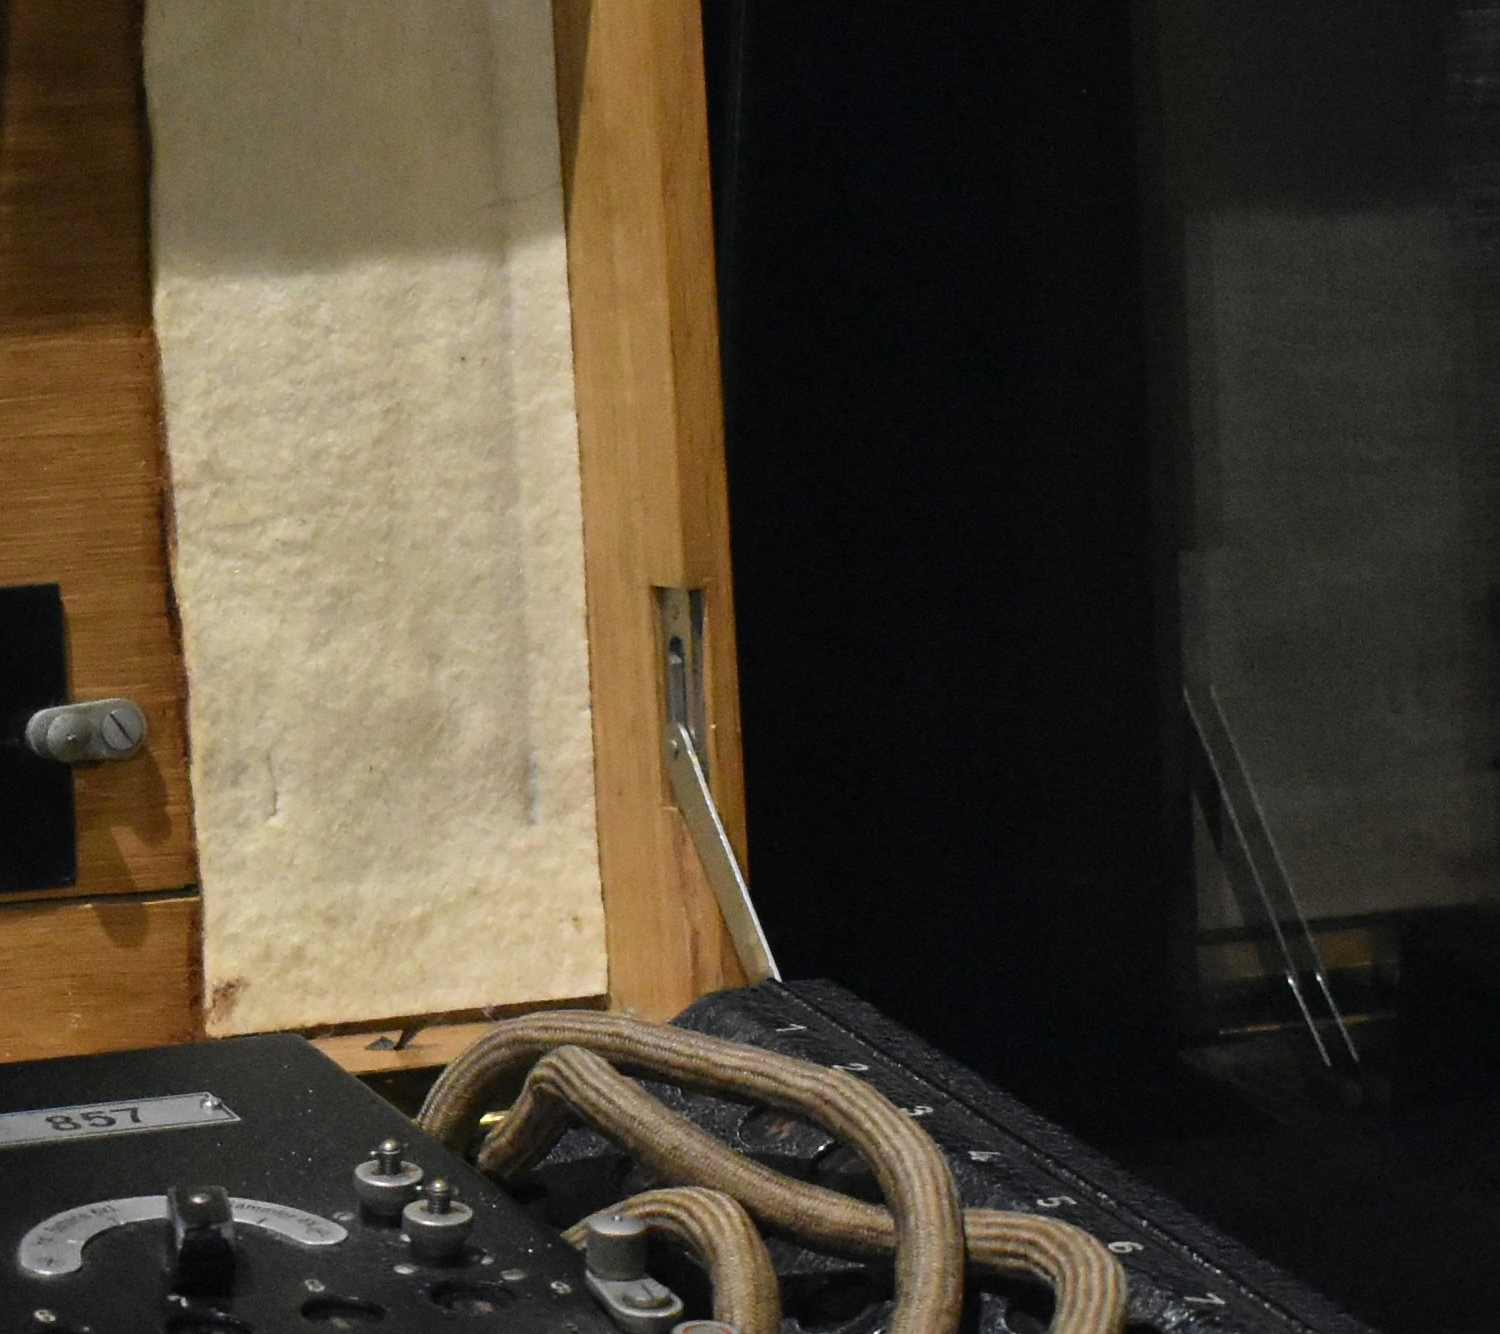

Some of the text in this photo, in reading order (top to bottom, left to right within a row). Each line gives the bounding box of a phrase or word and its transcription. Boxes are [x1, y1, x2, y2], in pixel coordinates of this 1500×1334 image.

[45, 1107, 143, 1133] 857
[1037, 1195, 1077, 1208] 5
[1107, 1241, 1144, 1254] 6
[1183, 1292, 1226, 1305] 7
